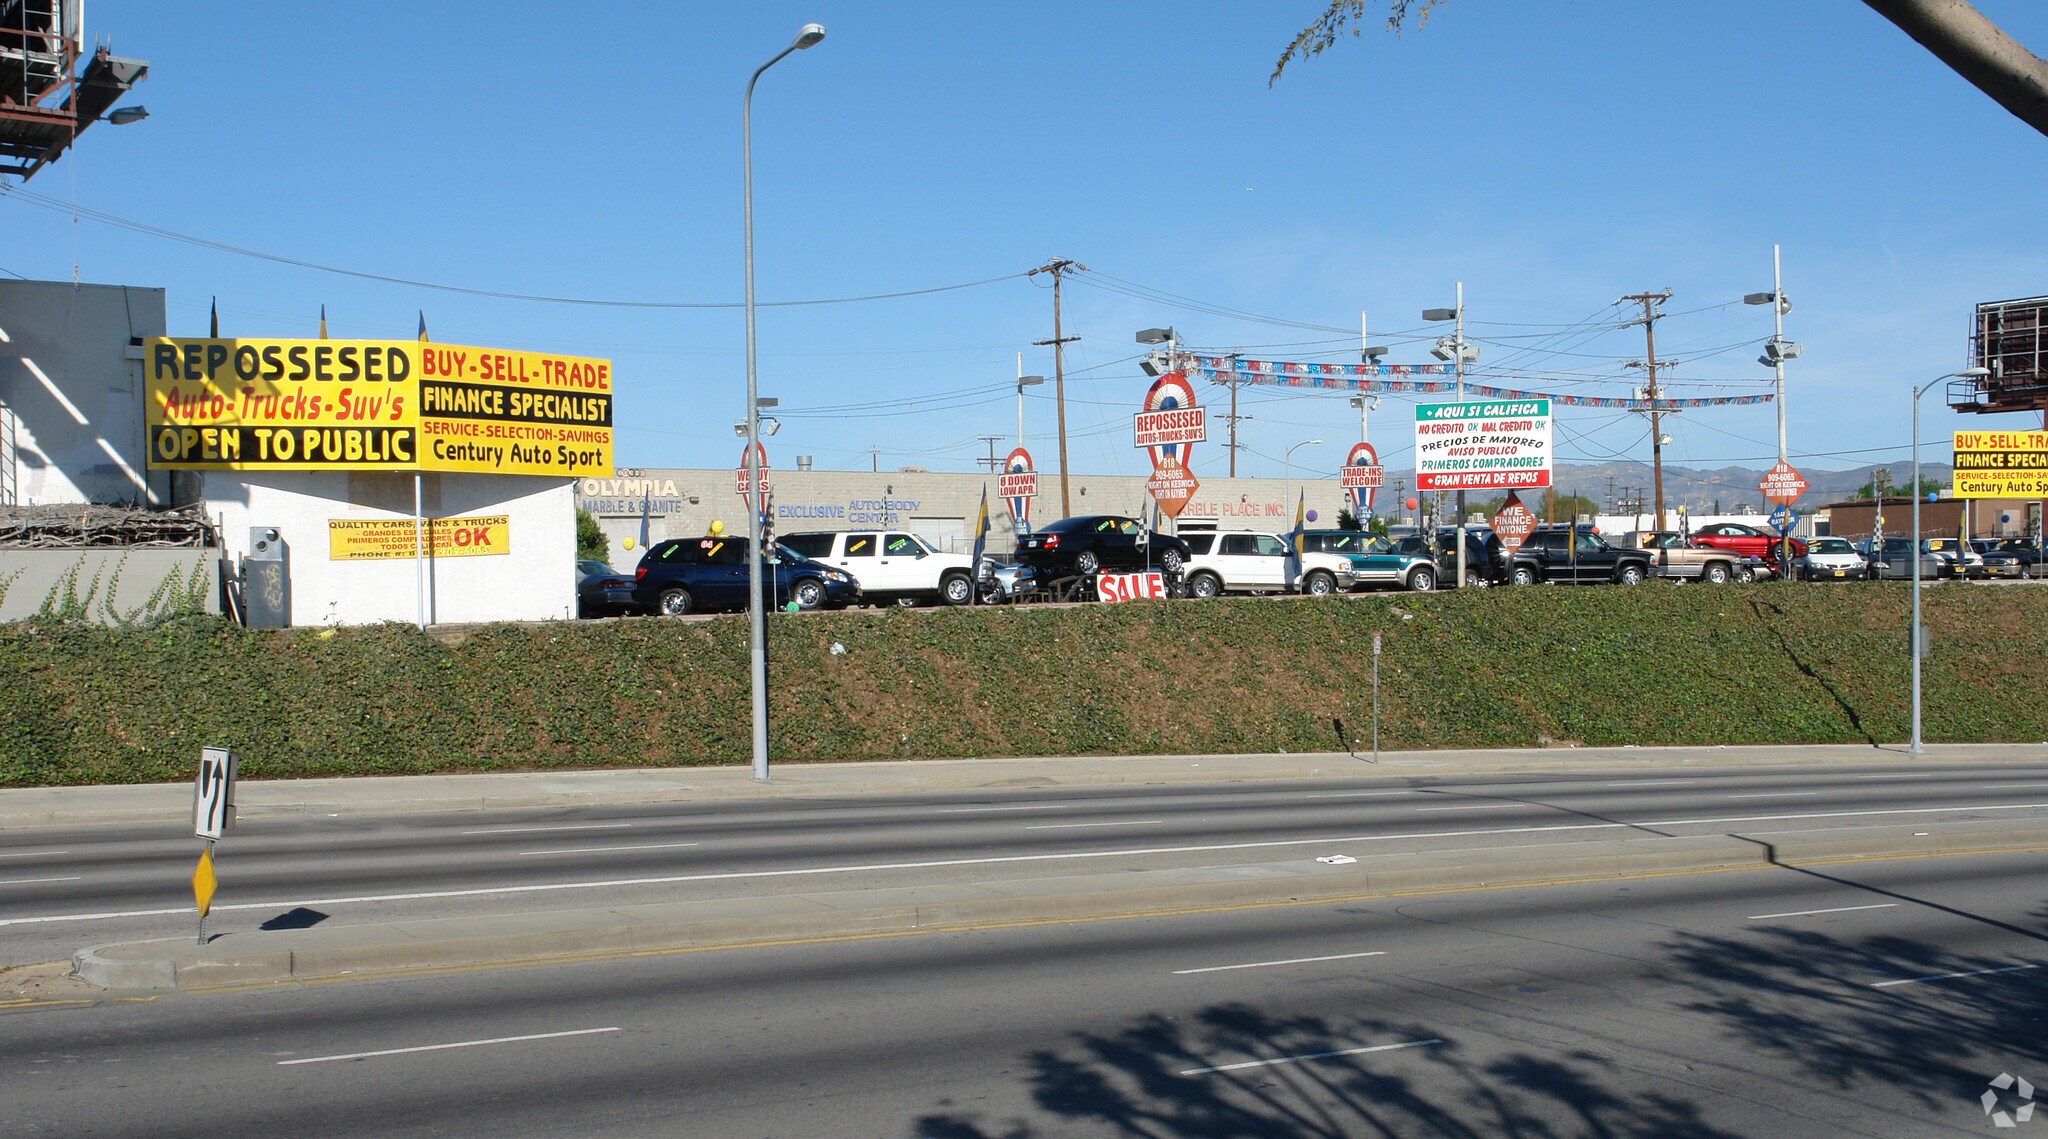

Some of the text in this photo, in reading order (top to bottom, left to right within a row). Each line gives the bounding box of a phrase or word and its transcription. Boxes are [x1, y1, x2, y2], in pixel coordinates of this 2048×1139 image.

[154, 344, 410, 382] REPOSSESED
[424, 386, 607, 421] FINANCE SPECIALIST
[1435, 404, 1538, 418] AQUI SI CALIFICA
[1137, 410, 1202, 433] REPOSSESED
[1419, 420, 1546, 435] NO CREDITO OK MAL CREDITO OK
[158, 428, 411, 462] OPEN TO PUBLIC
[1421, 436, 1544, 452] PRECIOS DE MAYOREO
[433, 439, 602, 471] Century Auto Sport
[1448, 446, 1518, 456] AVISO PUBLICO
[1163, 458, 1175, 468] 818
[1421, 457, 1544, 470] PRIMEROS COMPRADORES
[1956, 453, 2048, 467] FINANCE SPECIA
[1776, 464, 1787, 473] 818
[1008, 475, 1035, 485] DOWN
[1342, 477, 1382, 486] WELCOME
[1435, 472, 1538, 486] GRAN VENTA DE REPOS
[583, 479, 679, 497] OLYMPIA
[737, 482, 769, 491] CS
[1001, 486, 1017, 496] LOW
[1961, 481, 2003, 495] Century
[2007, 481, 2032, 492] Auto
[628, 501, 635, 512] &
[778, 505, 845, 518] EXCLUSIVE
[849, 500, 920, 510] AUTO BODY
[1180, 502, 1286, 516] ARBLE PLACE INC.
[1503, 507, 1523, 516] WE
[329, 521, 379, 529] QUALITY
[421, 519, 449, 527] VANS
[464, 518, 507, 526] TRUCKS
[1494, 516, 1531, 525] FINANCE
[403, 528, 452, 536] ESPCIALES
[454, 527, 491, 547] OK
[1100, 574, 1164, 602] SALE
